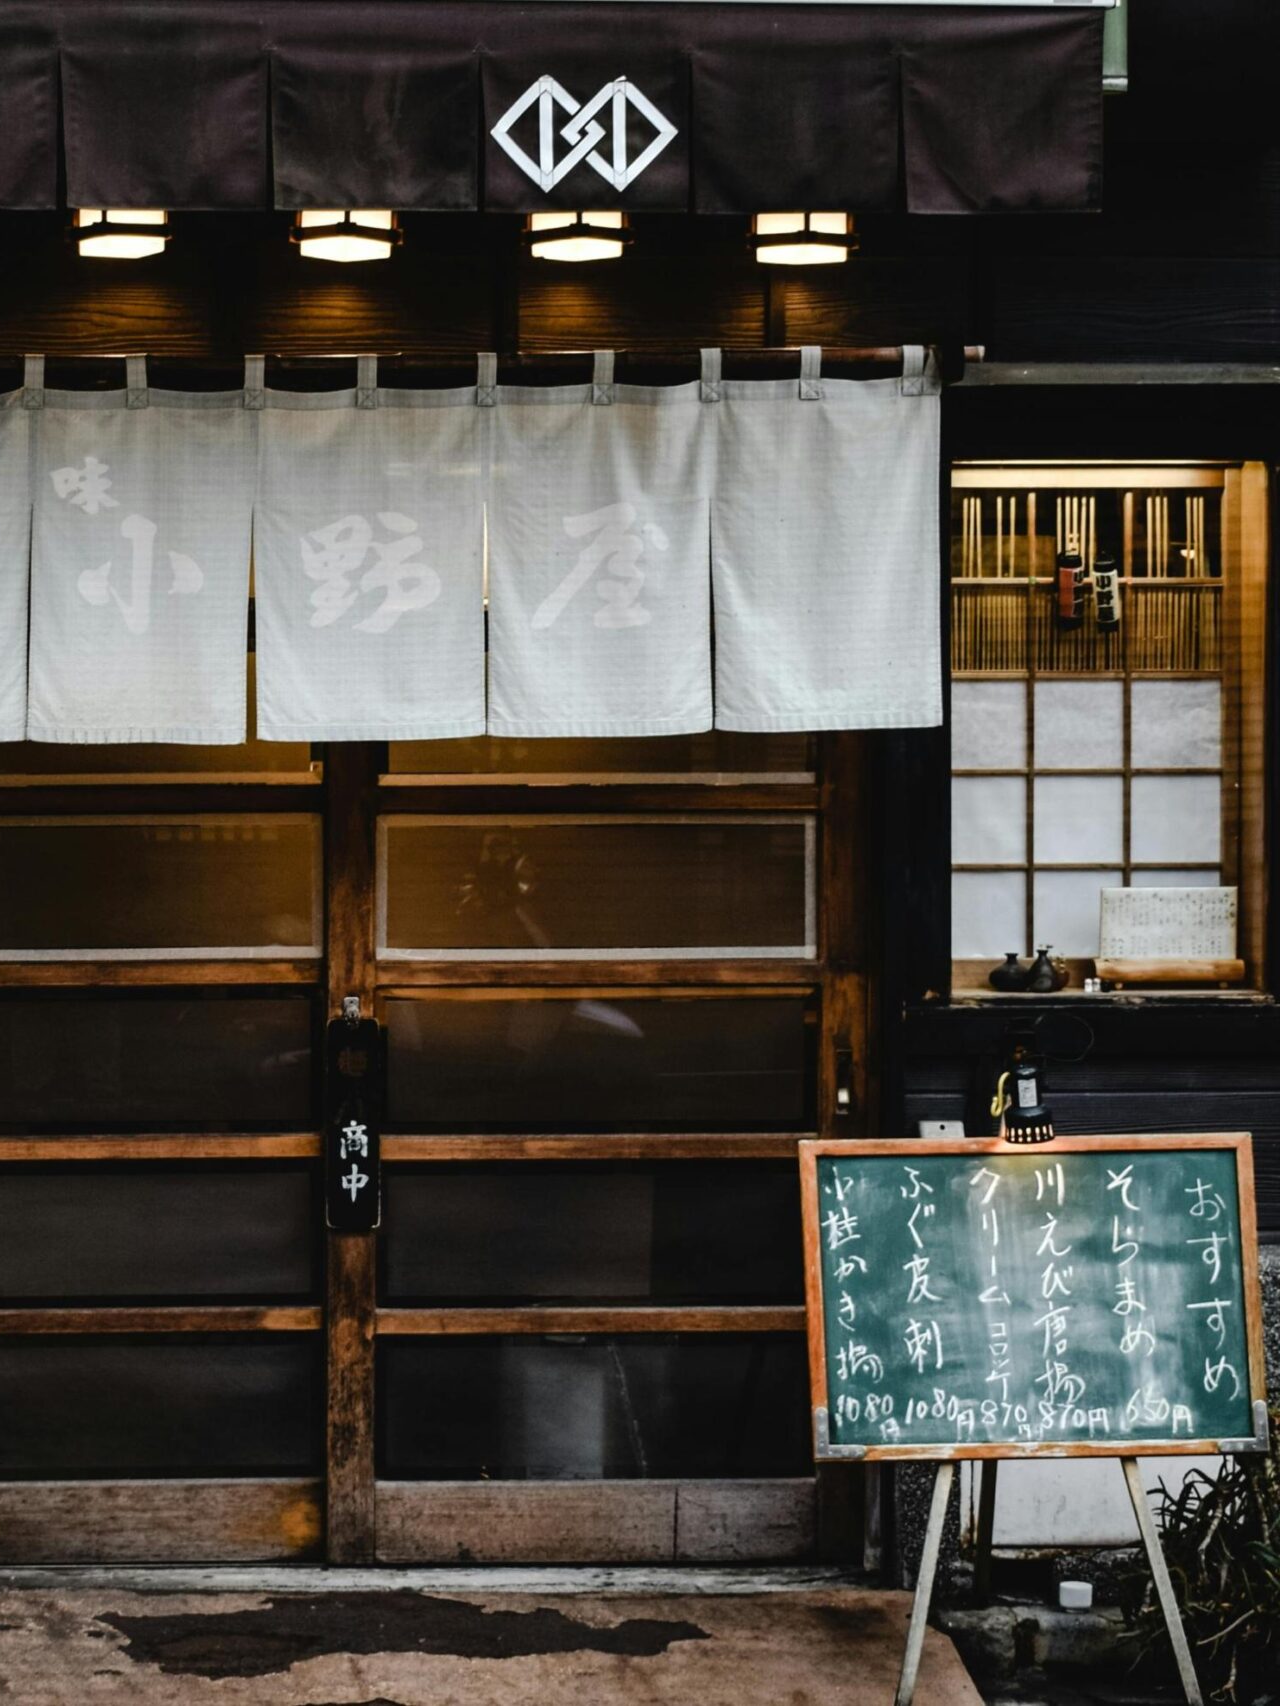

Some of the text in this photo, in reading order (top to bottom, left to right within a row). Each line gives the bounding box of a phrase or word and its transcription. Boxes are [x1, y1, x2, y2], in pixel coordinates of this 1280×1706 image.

[900, 1166, 943, 1373] ふぐ皮刺
[1035, 1163, 1086, 1403] 川えび唐揚
[1107, 1164, 1156, 1356] そらまめ
[1183, 1178, 1240, 1400] おすすめ
